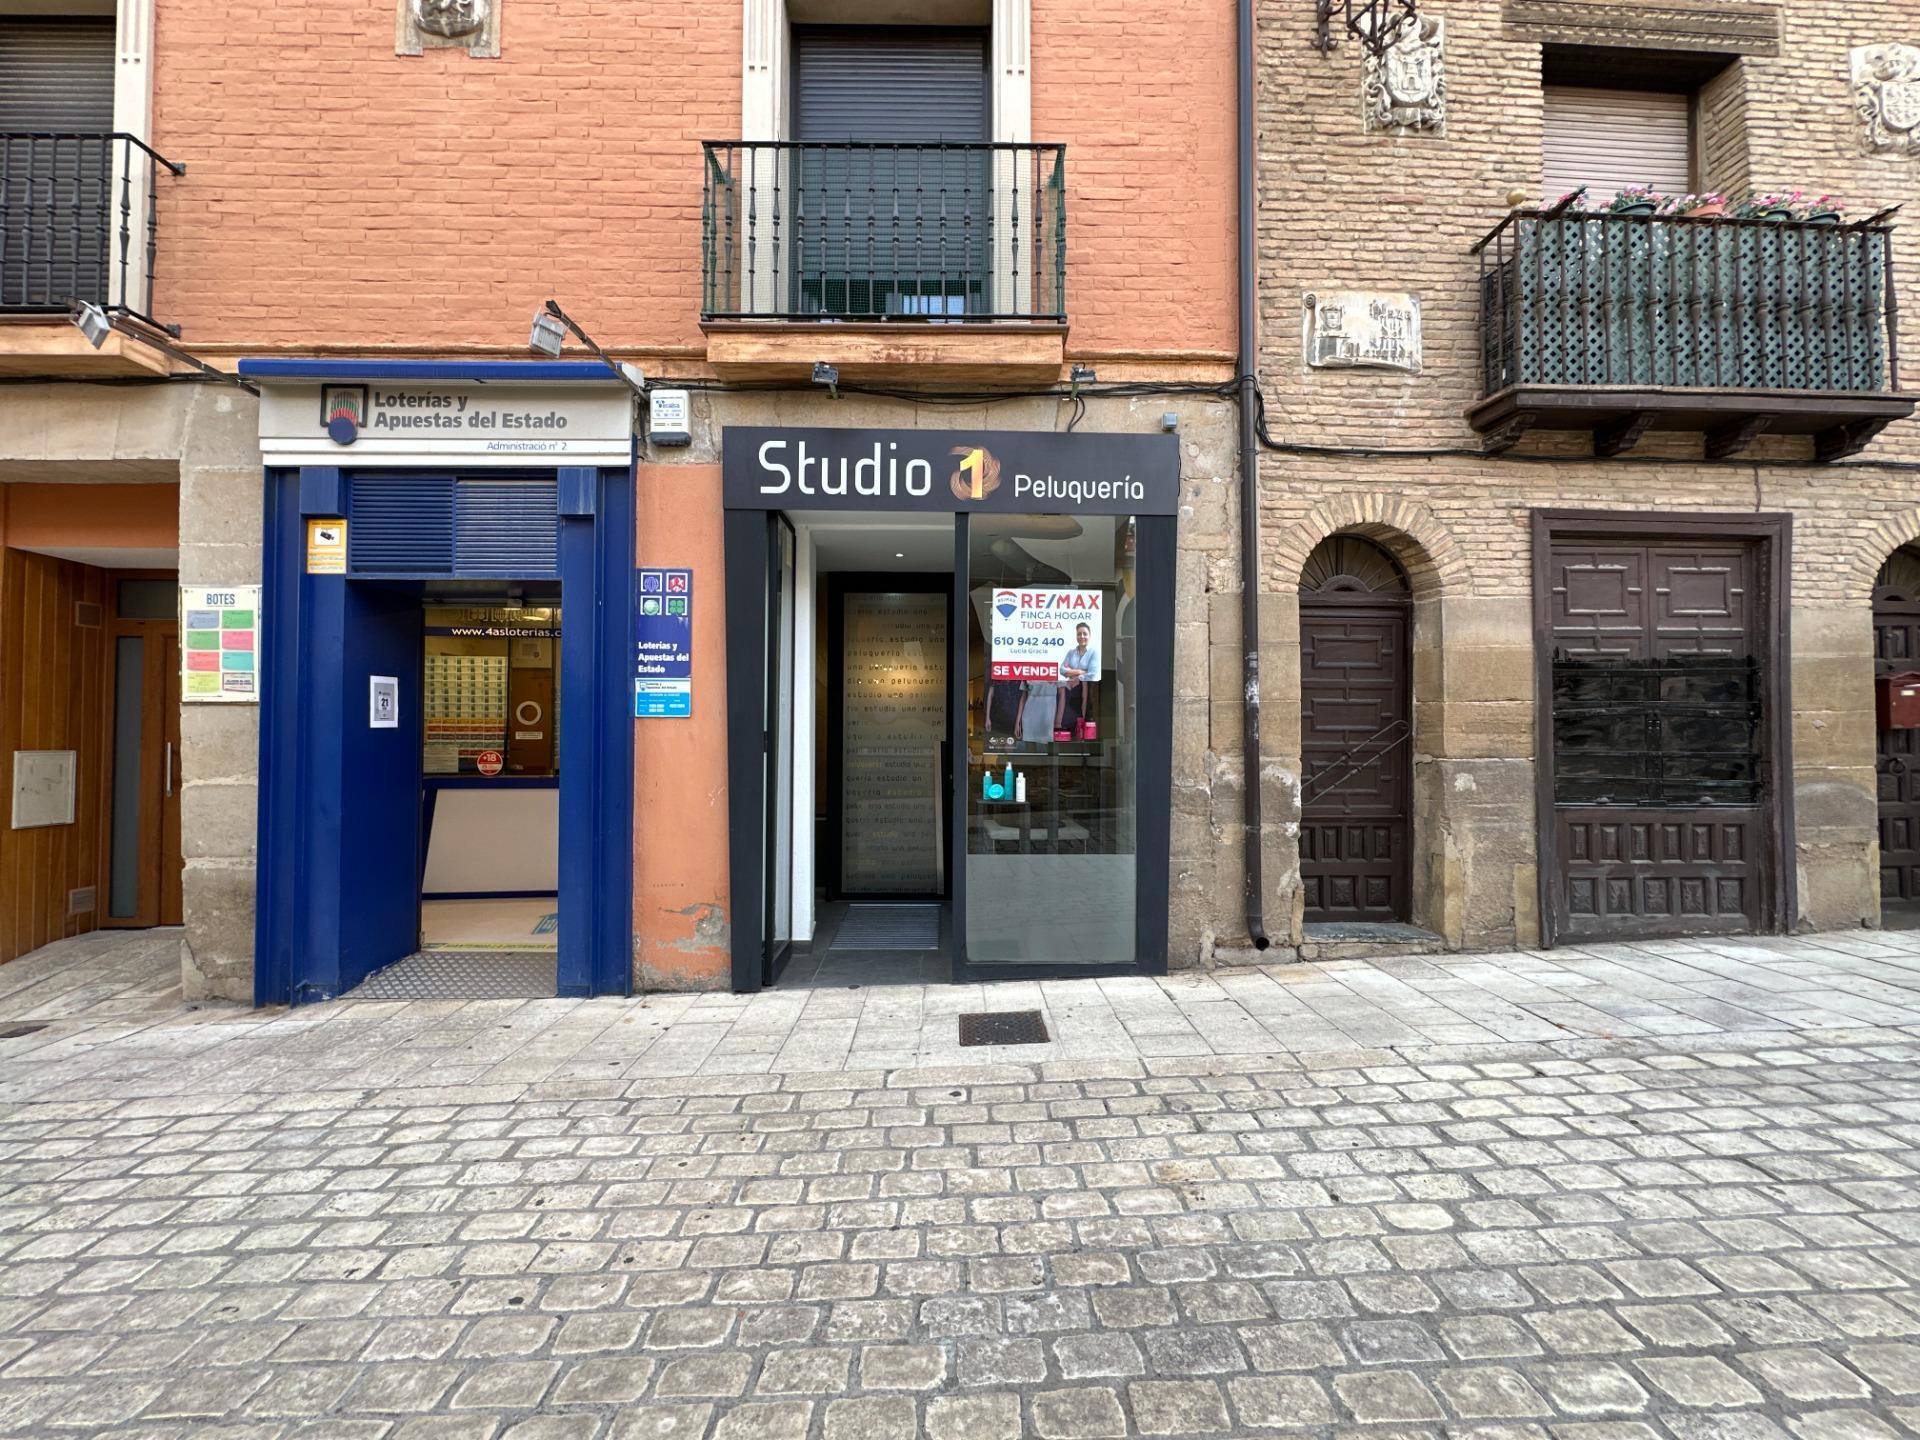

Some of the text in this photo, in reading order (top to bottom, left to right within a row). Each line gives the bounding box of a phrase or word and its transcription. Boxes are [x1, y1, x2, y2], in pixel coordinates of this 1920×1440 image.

[374, 391, 468, 412] Loterías y
[374, 411, 568, 431] Apuestas del Estado
[561, 442, 567, 451] 2
[758, 440, 984, 499] Studio 1
[1014, 474, 1145, 505] Peluquería
[206, 593, 236, 605] BOTES
[1021, 593, 1100, 610] RE/MAX
[1020, 611, 1092, 620] FINCA HOGAR
[1021, 621, 1063, 630] TUDELA
[993, 636, 1065, 646] 610 942 440
[672, 642, 678, 652] y
[637, 652, 690, 664] Apuestas del
[638, 664, 666, 673] Estado
[993, 665, 1057, 677] SE VENDE
[381, 697, 389, 707] 21
[482, 753, 497, 762] +18
